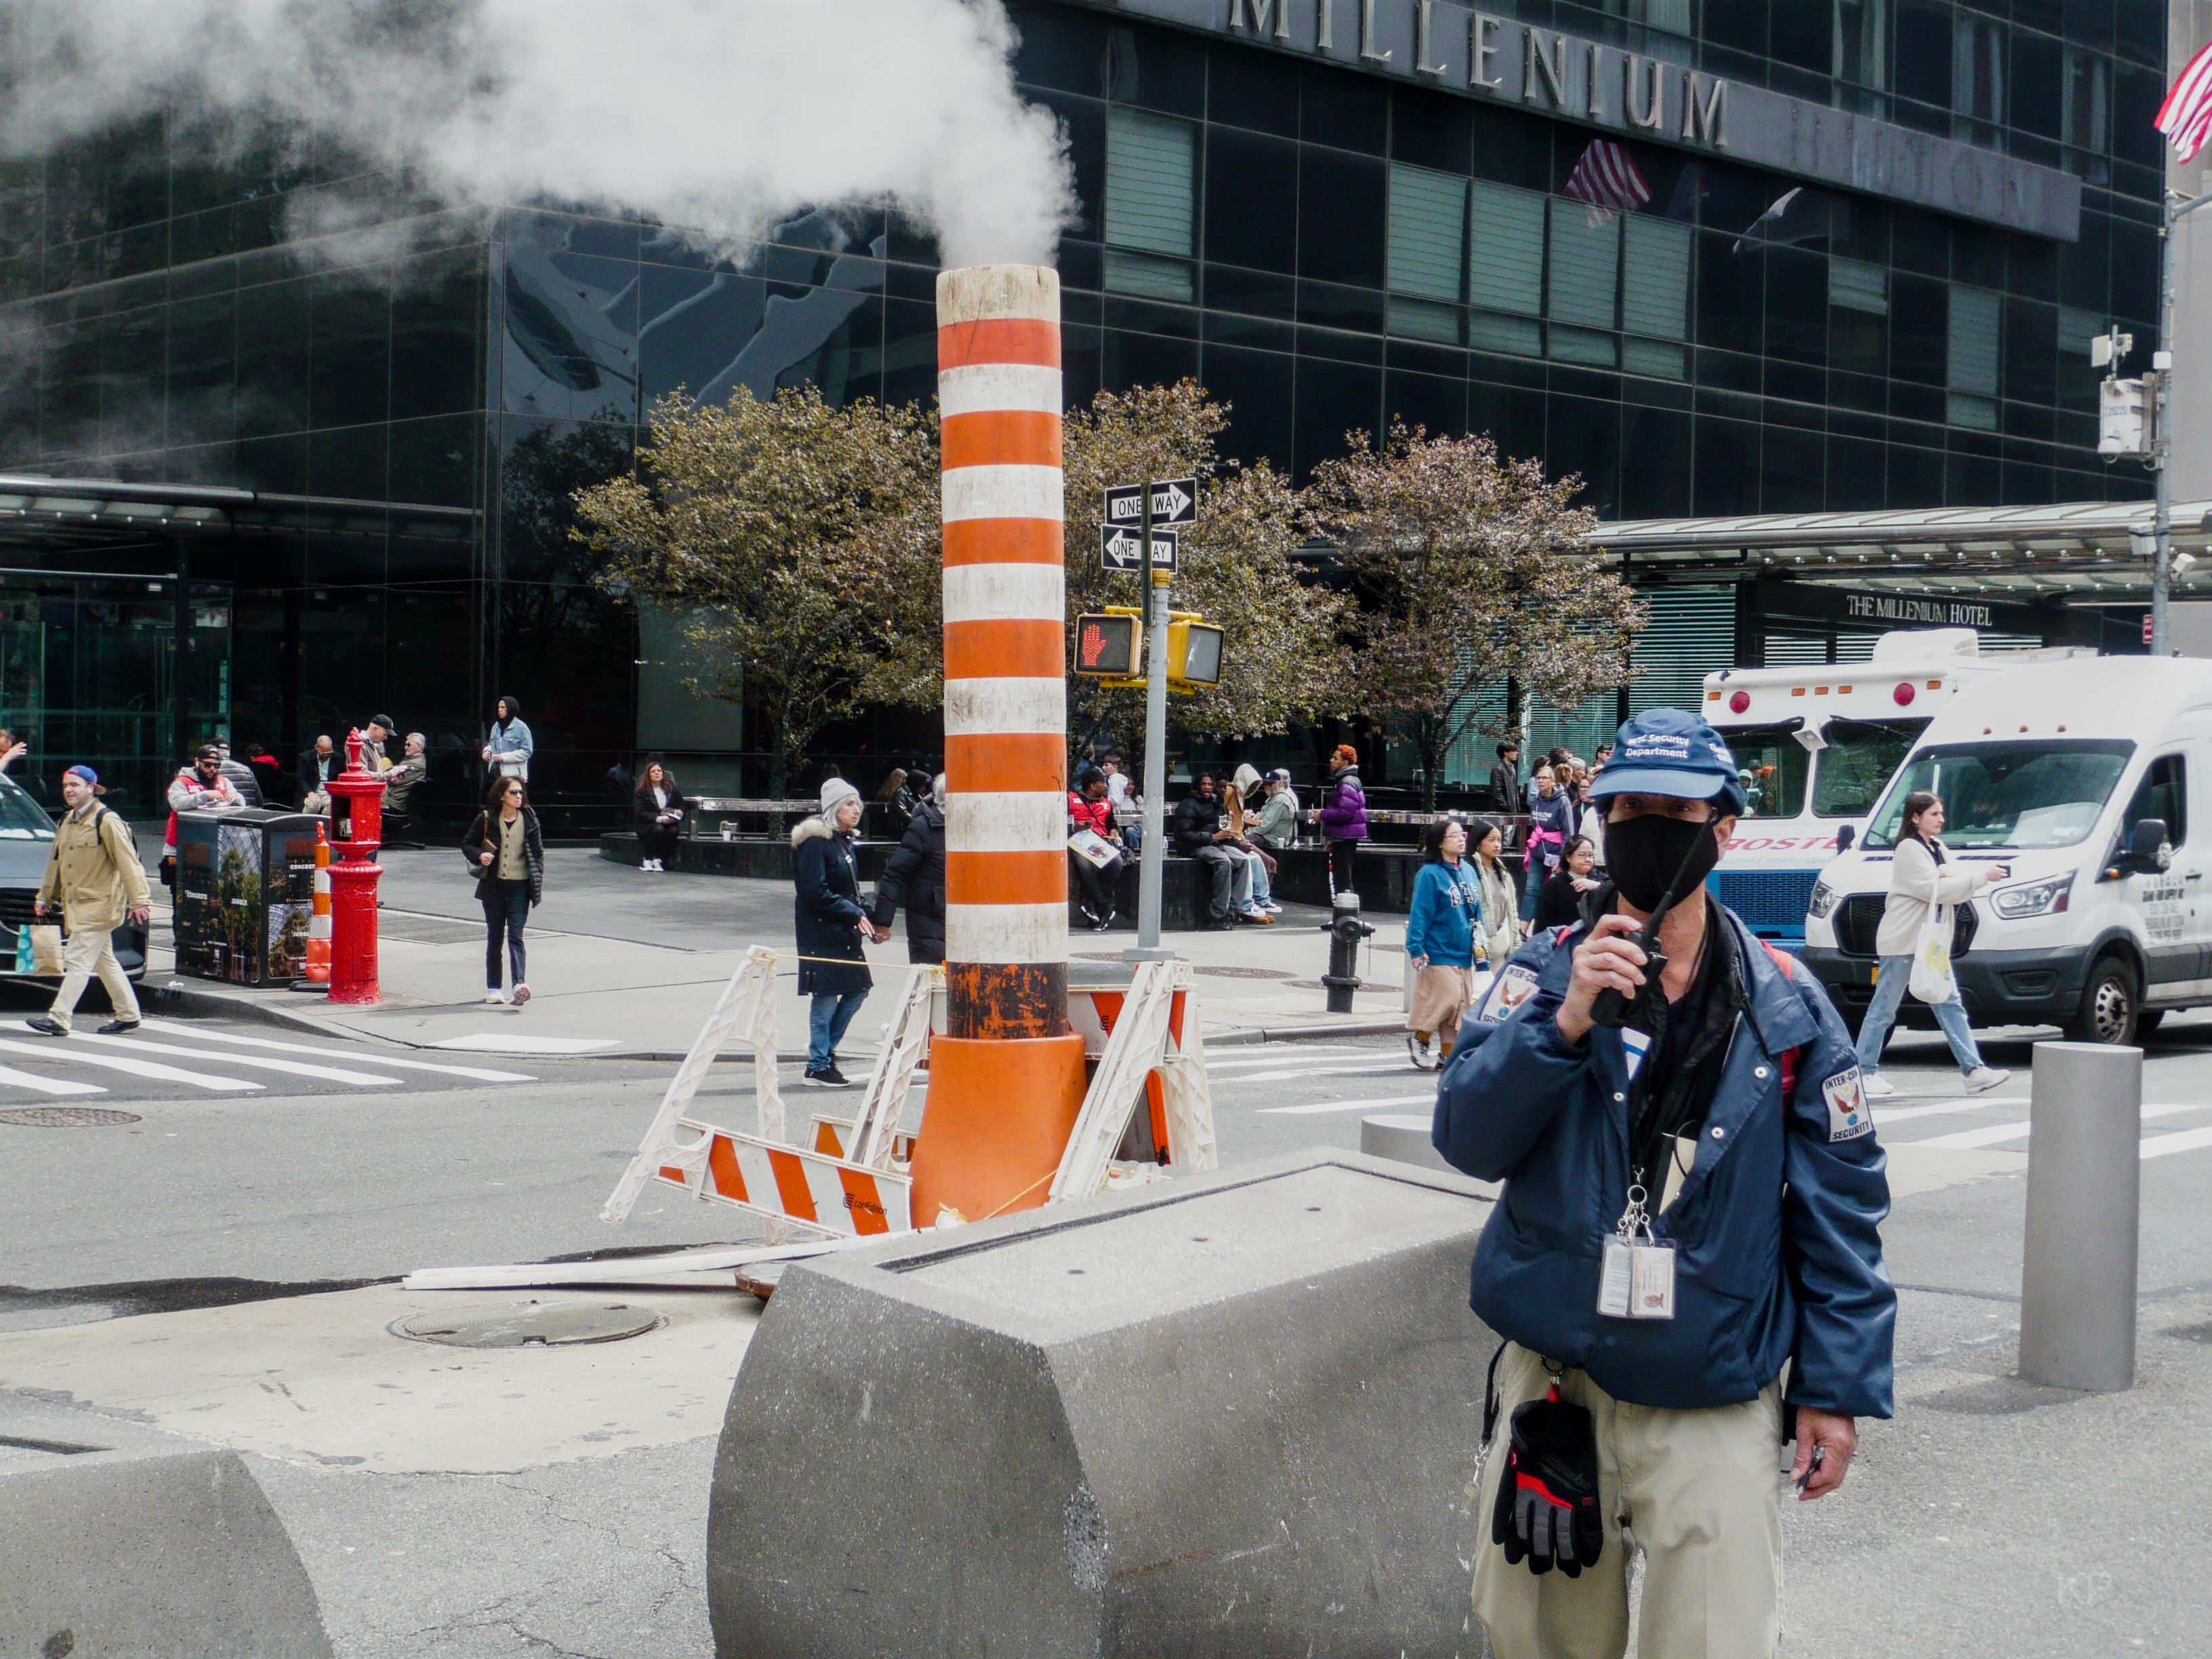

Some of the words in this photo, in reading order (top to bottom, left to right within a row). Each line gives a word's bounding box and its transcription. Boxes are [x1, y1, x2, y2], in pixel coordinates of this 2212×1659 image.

[1118, 497, 1141, 516] ONE
[1155, 493, 1181, 512] WAY
[1113, 539, 1134, 556] ONE
[1153, 544, 1166, 560] AY
[1847, 594, 1875, 617] THE
[1877, 598, 1946, 623] MILLENIUM
[1950, 604, 1992, 627] HOTEL
[1648, 734, 1689, 746] Security
[1626, 747, 1688, 758] Department
[1832, 1120, 1870, 1140] SECURITY
